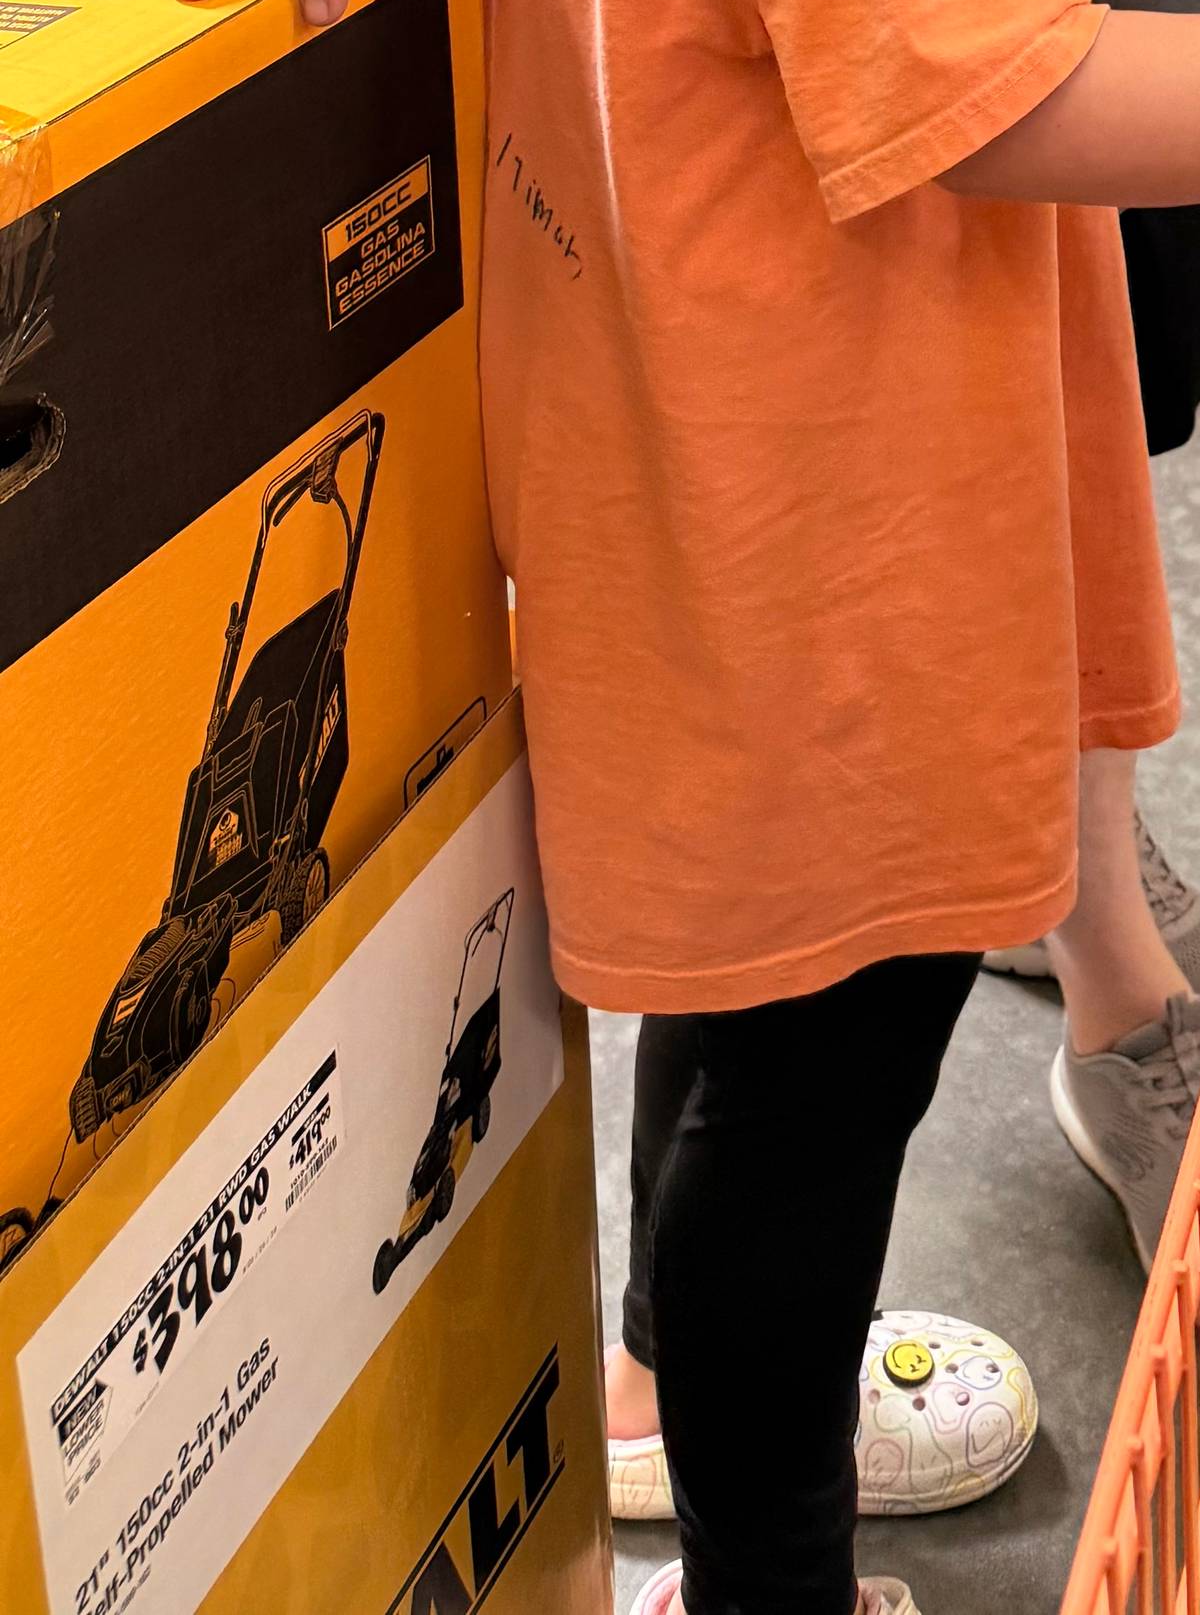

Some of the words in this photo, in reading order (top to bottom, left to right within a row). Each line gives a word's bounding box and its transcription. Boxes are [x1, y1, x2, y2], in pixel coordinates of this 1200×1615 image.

[345, 181, 412, 242] 150CC
[361, 219, 400, 259] GAS
[335, 221, 426, 298] GASOLINA
[339, 239, 425, 315] ESSENCE
[53, 1339, 109, 1418] DEWALT
[112, 1267, 157, 1345] 150CC
[156, 1230, 198, 1283] 2-IN-1
[199, 1206, 215, 1233] 21
[217, 1166, 249, 1208] RWD
[250, 1129, 277, 1168] GAS
[276, 1083, 314, 1133] WALK
[63, 1399, 105, 1457] LOWER
[66, 1386, 104, 1433] NEW
[67, 1418, 104, 1466] PRICE
[75, 1549, 110, 1612] 21"
[115, 1469, 174, 1555] 150cc
[177, 1385, 231, 1474] 2-in-1
[236, 1336, 271, 1392] Gas
[87, 1443, 215, 1615] elf-Propelled
[218, 1356, 279, 1453] Mower
